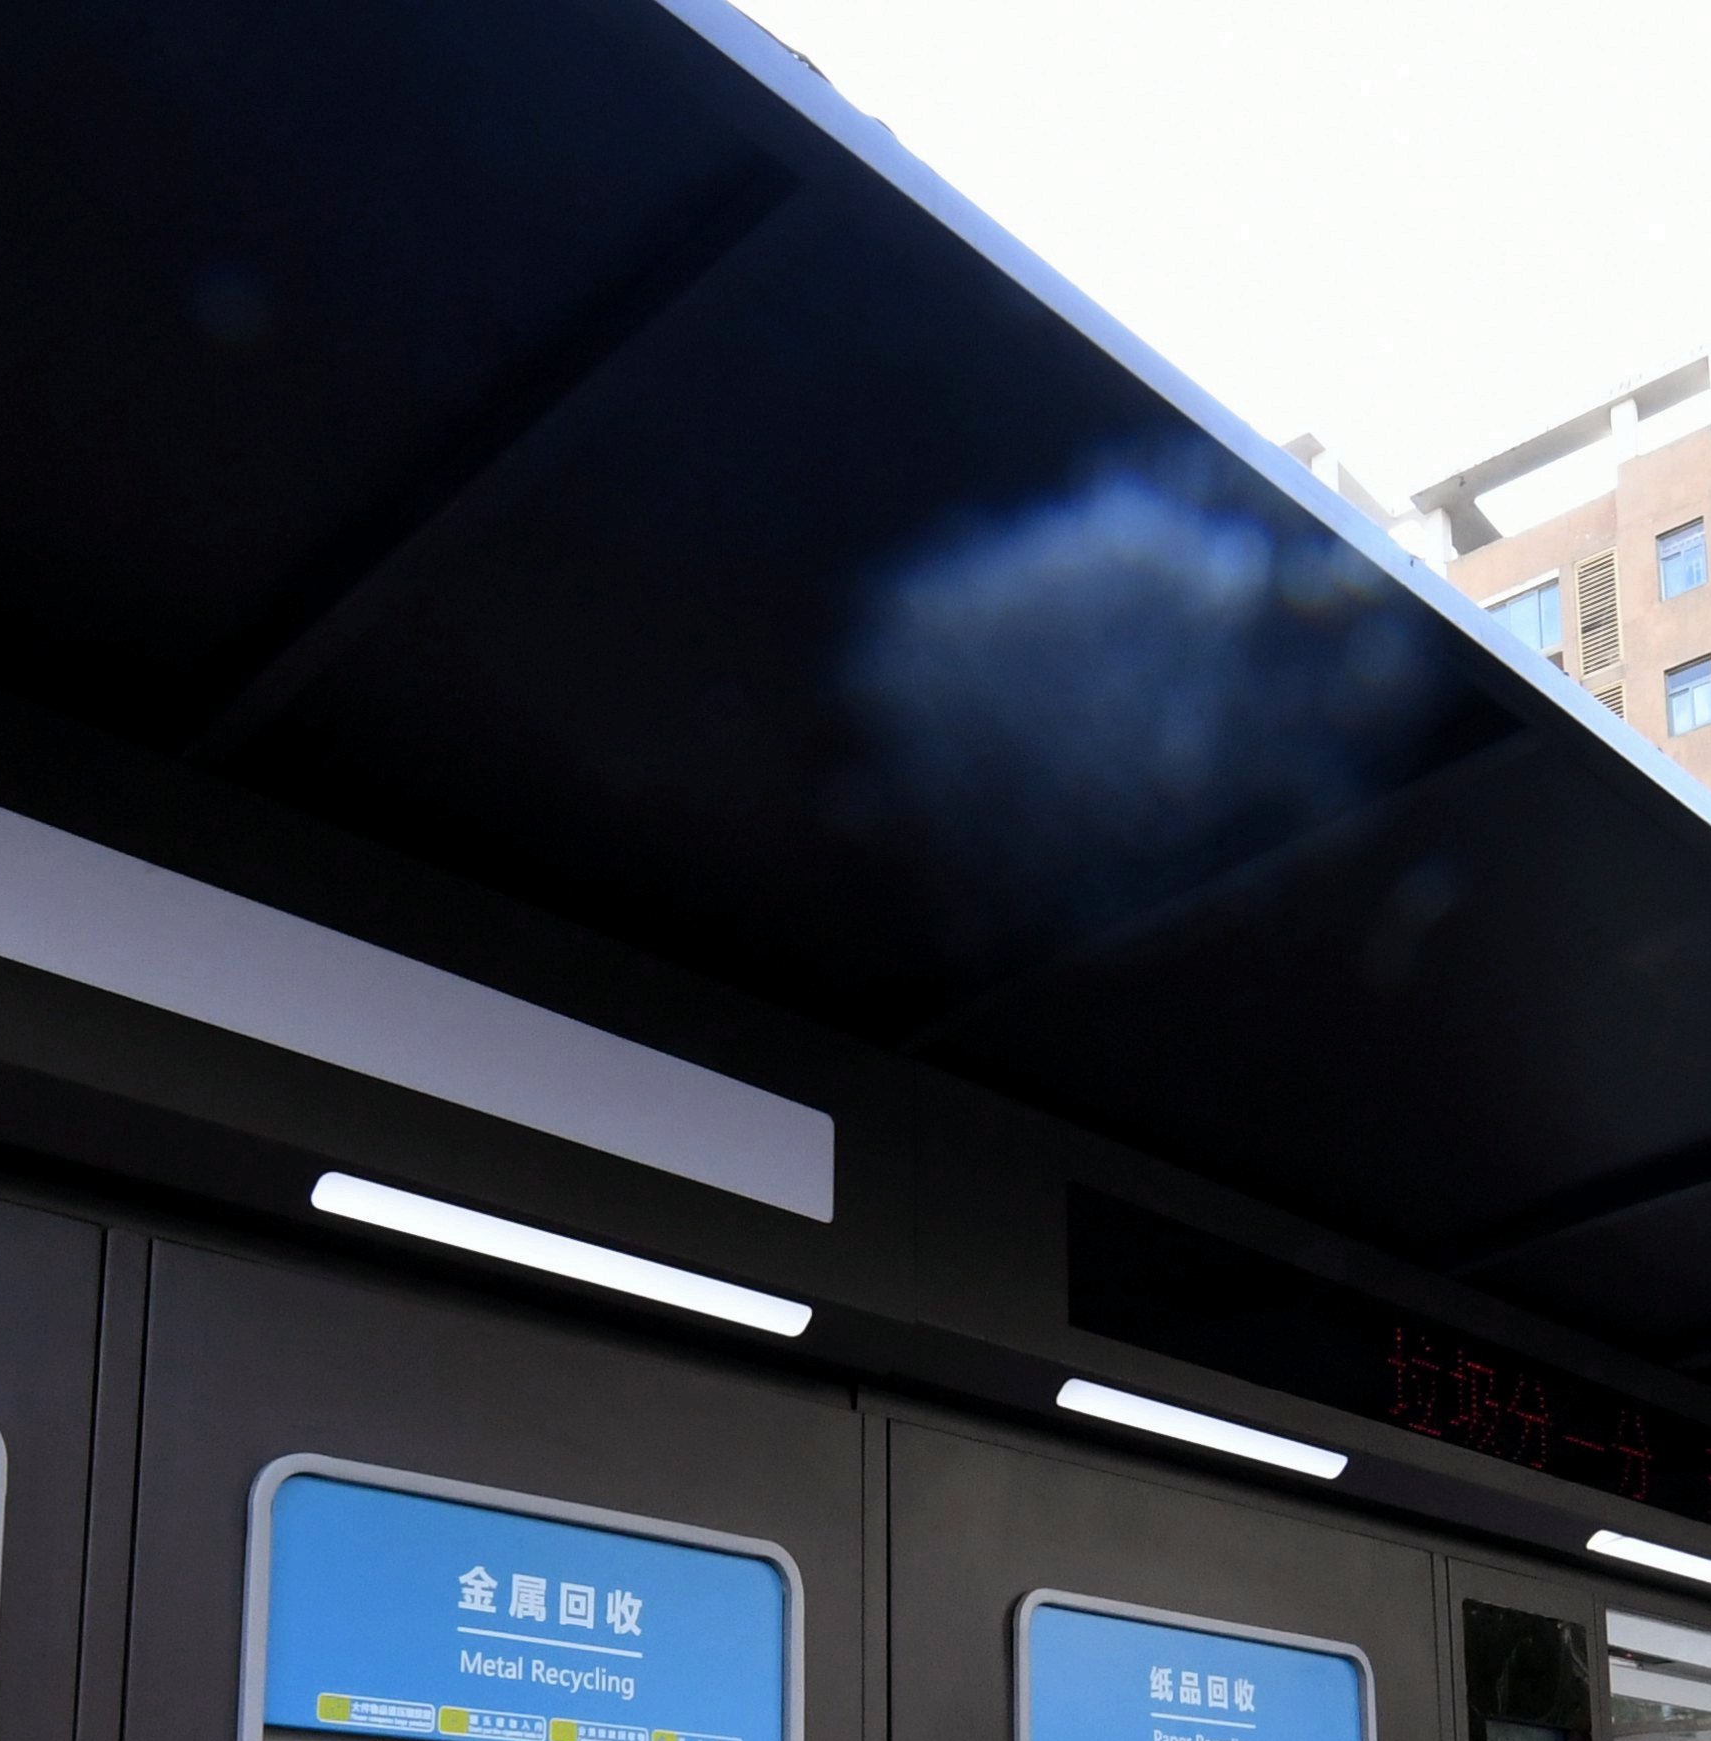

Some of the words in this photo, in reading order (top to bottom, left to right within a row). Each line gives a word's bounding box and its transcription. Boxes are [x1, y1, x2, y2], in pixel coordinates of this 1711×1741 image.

[457, 1565, 644, 1637] 金属回收
[460, 1649, 523, 1682] Metal
[531, 1659, 636, 1701] Recycling
[1149, 1666, 1256, 1713] 纸品回收
